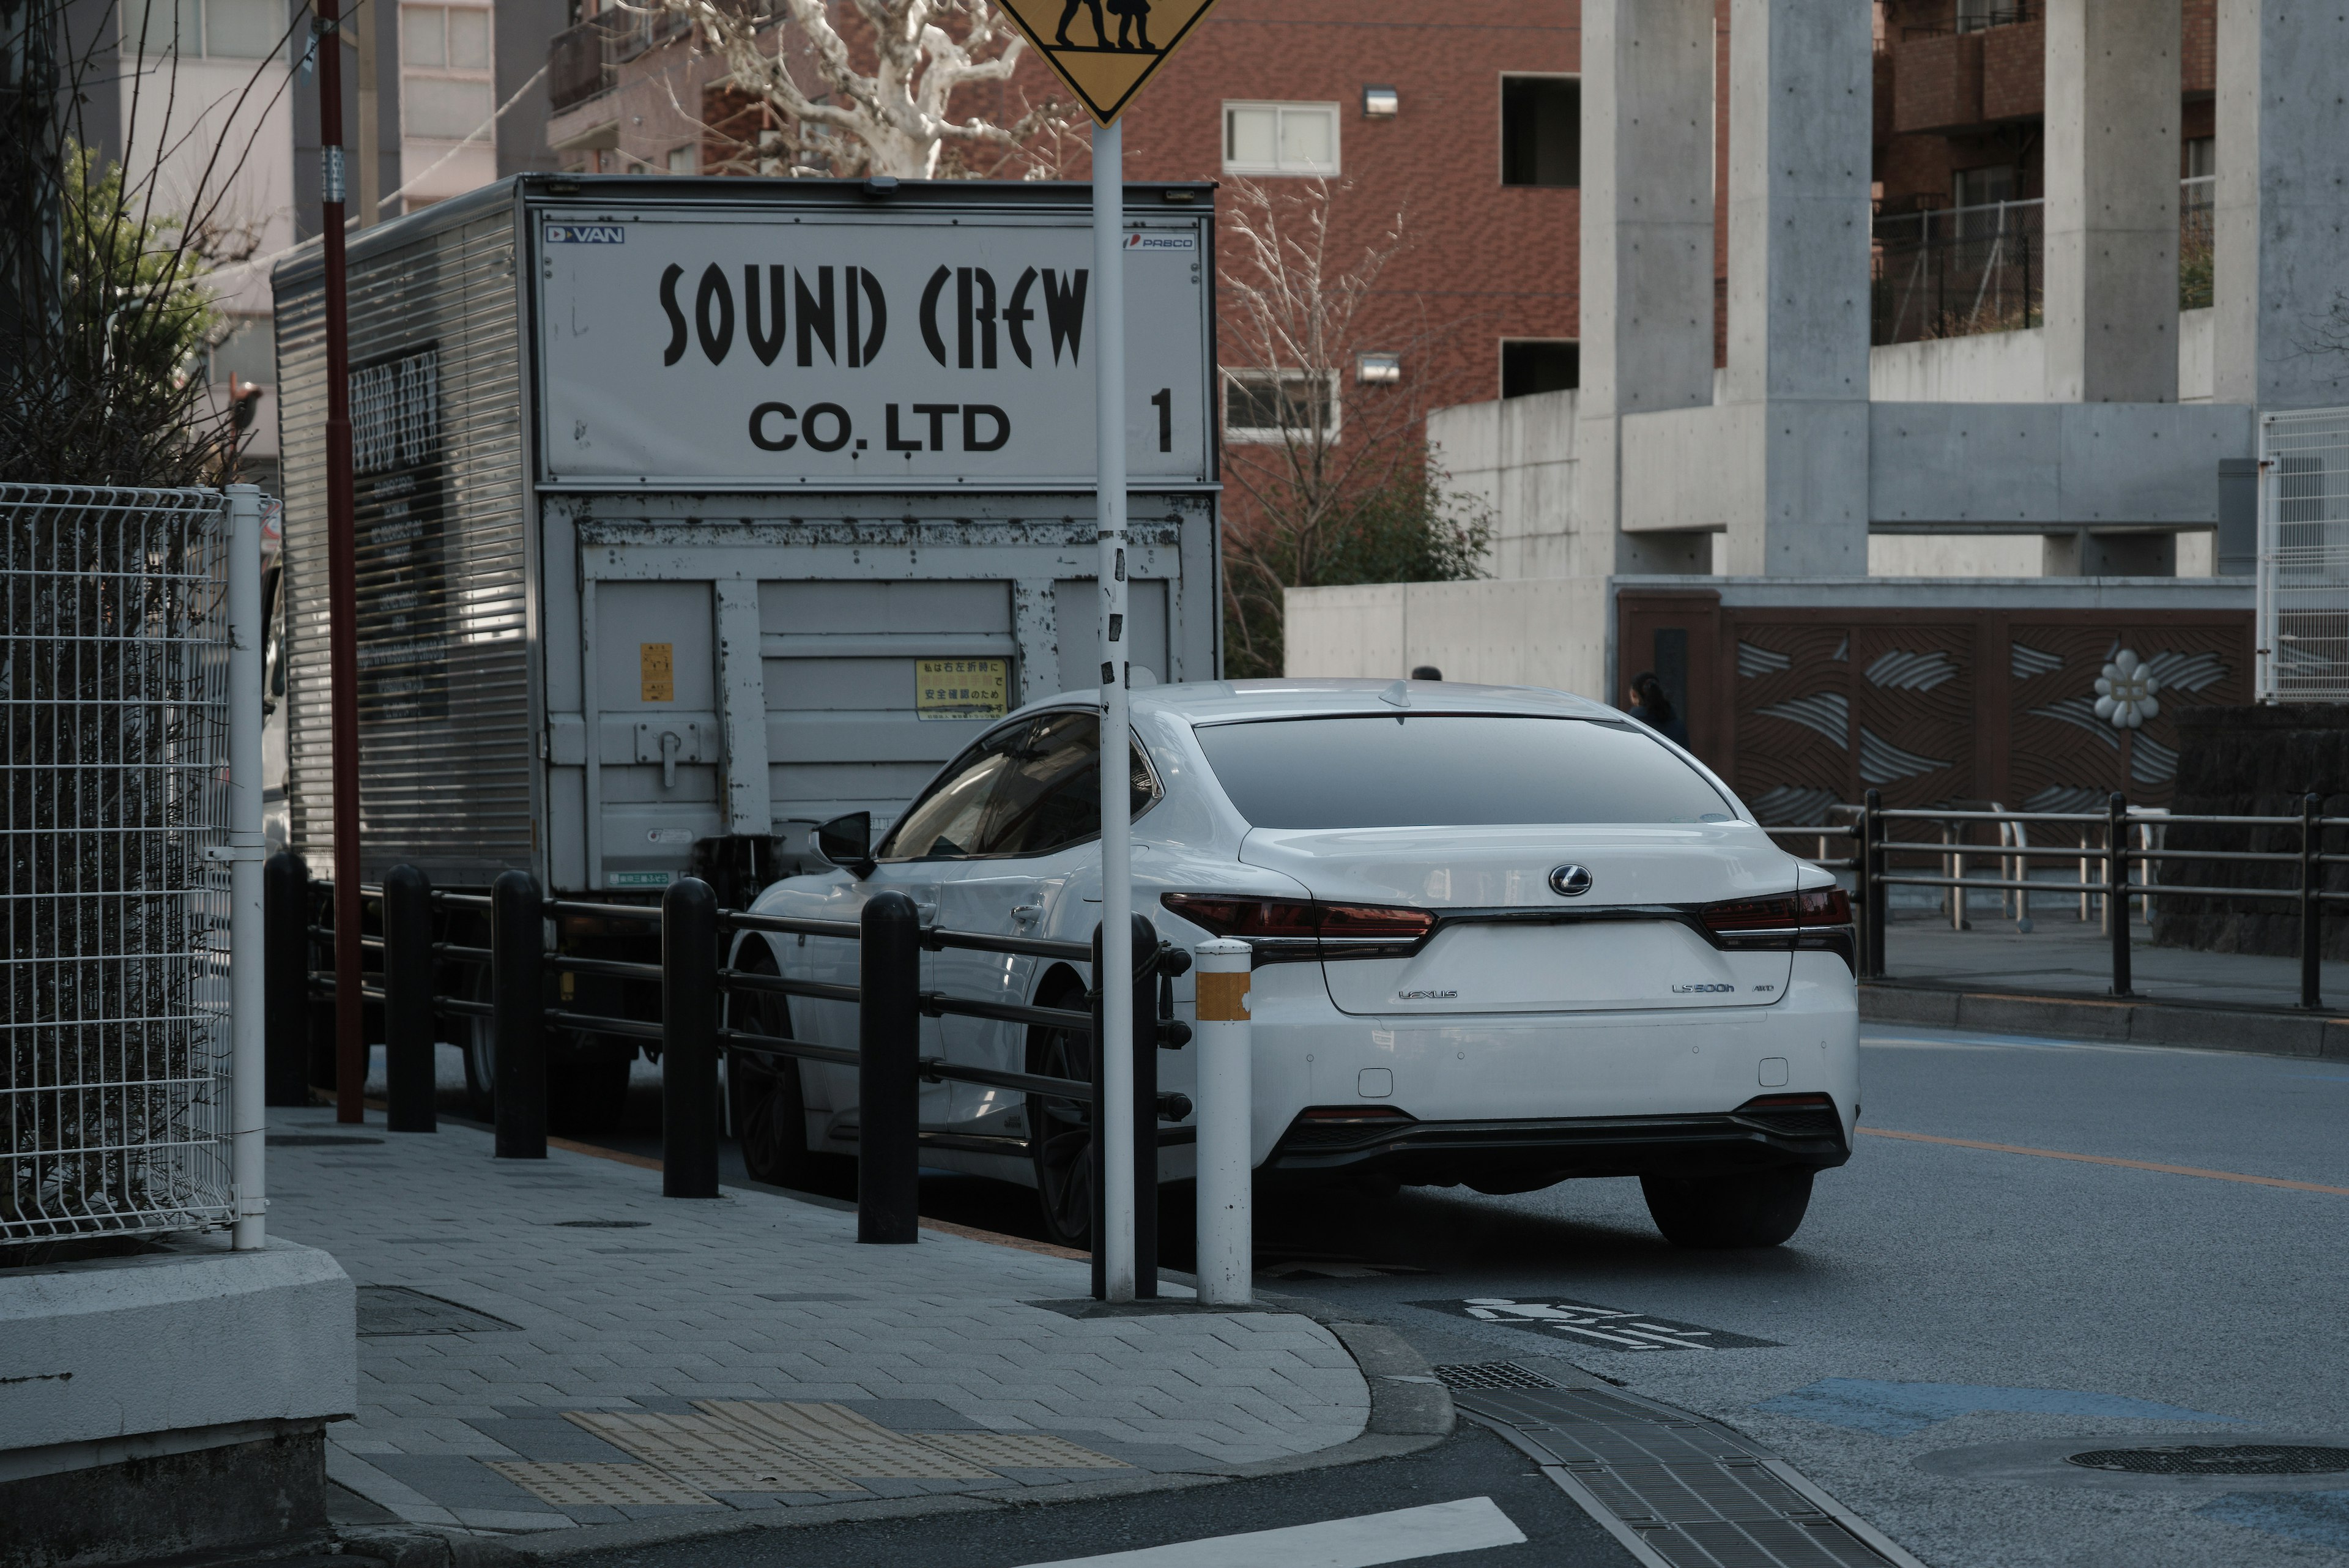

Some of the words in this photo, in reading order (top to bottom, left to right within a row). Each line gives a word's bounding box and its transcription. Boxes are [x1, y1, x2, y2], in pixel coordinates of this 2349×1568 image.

[660, 262, 887, 367] SOUND
[919, 264, 1089, 368] CREW
[1151, 388, 1171, 452] 1
[924, 662, 998, 672] 私は右左折時に
[925, 689, 999, 699] 安全確認のため
[1399, 990, 1457, 999] LEXUS
